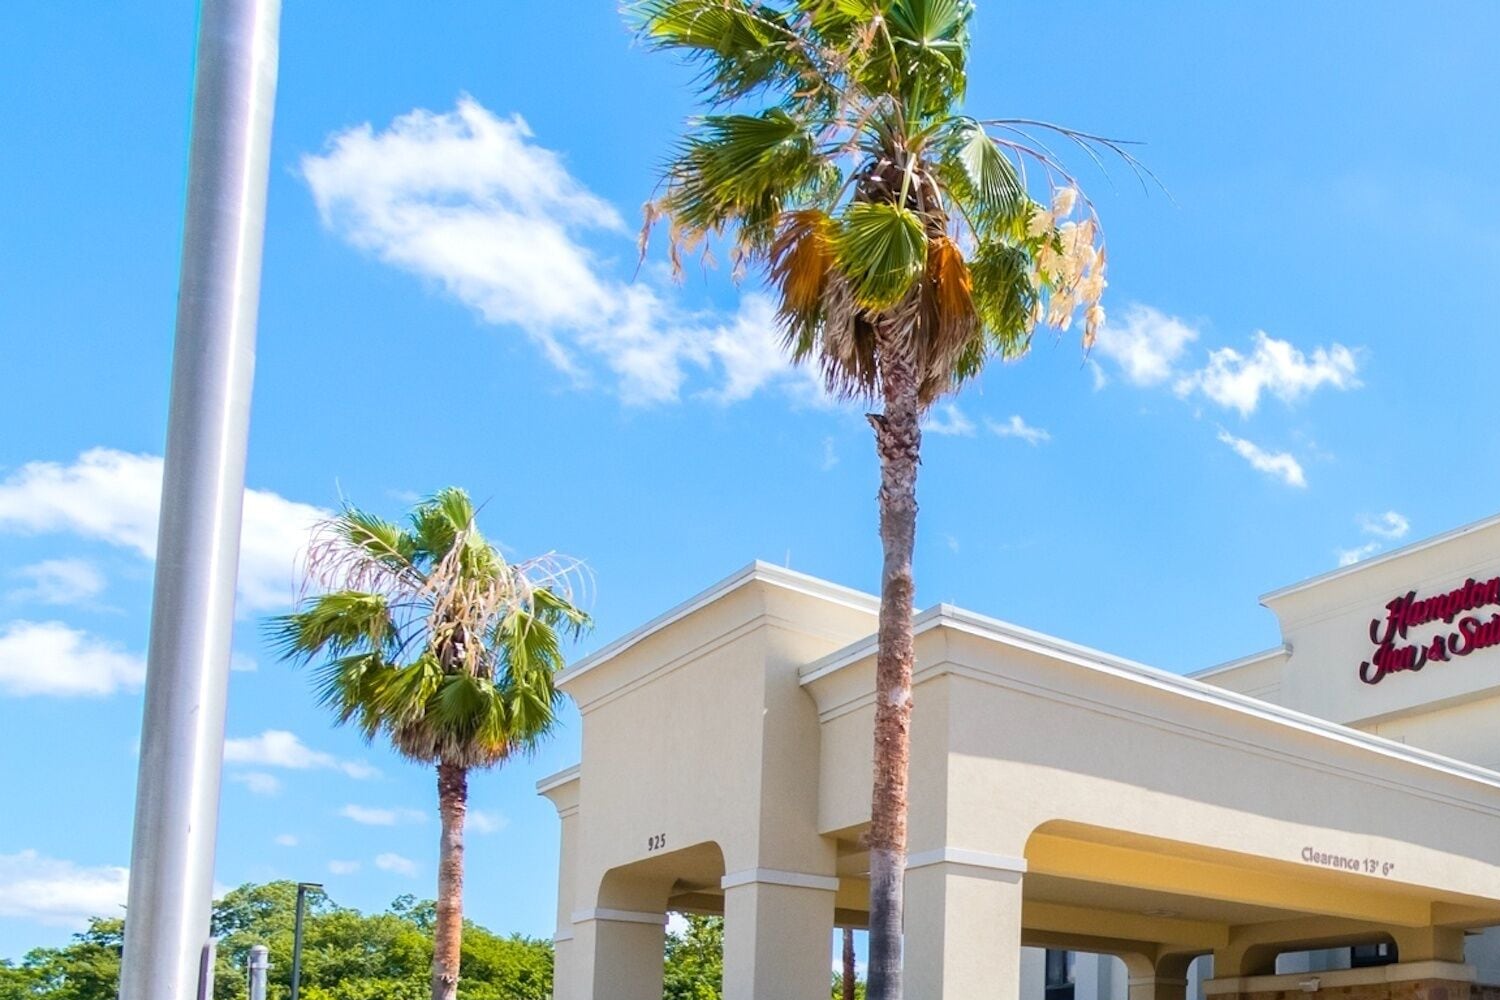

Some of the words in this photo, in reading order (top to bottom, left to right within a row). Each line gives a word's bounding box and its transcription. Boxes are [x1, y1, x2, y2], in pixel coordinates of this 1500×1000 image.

[1359, 643, 1428, 685] Inn
[1427, 635, 1450, 662] &
[648, 833, 666, 851] 925
[1301, 846, 1360, 871] Clearance
[1363, 857, 1379, 873] 13'
